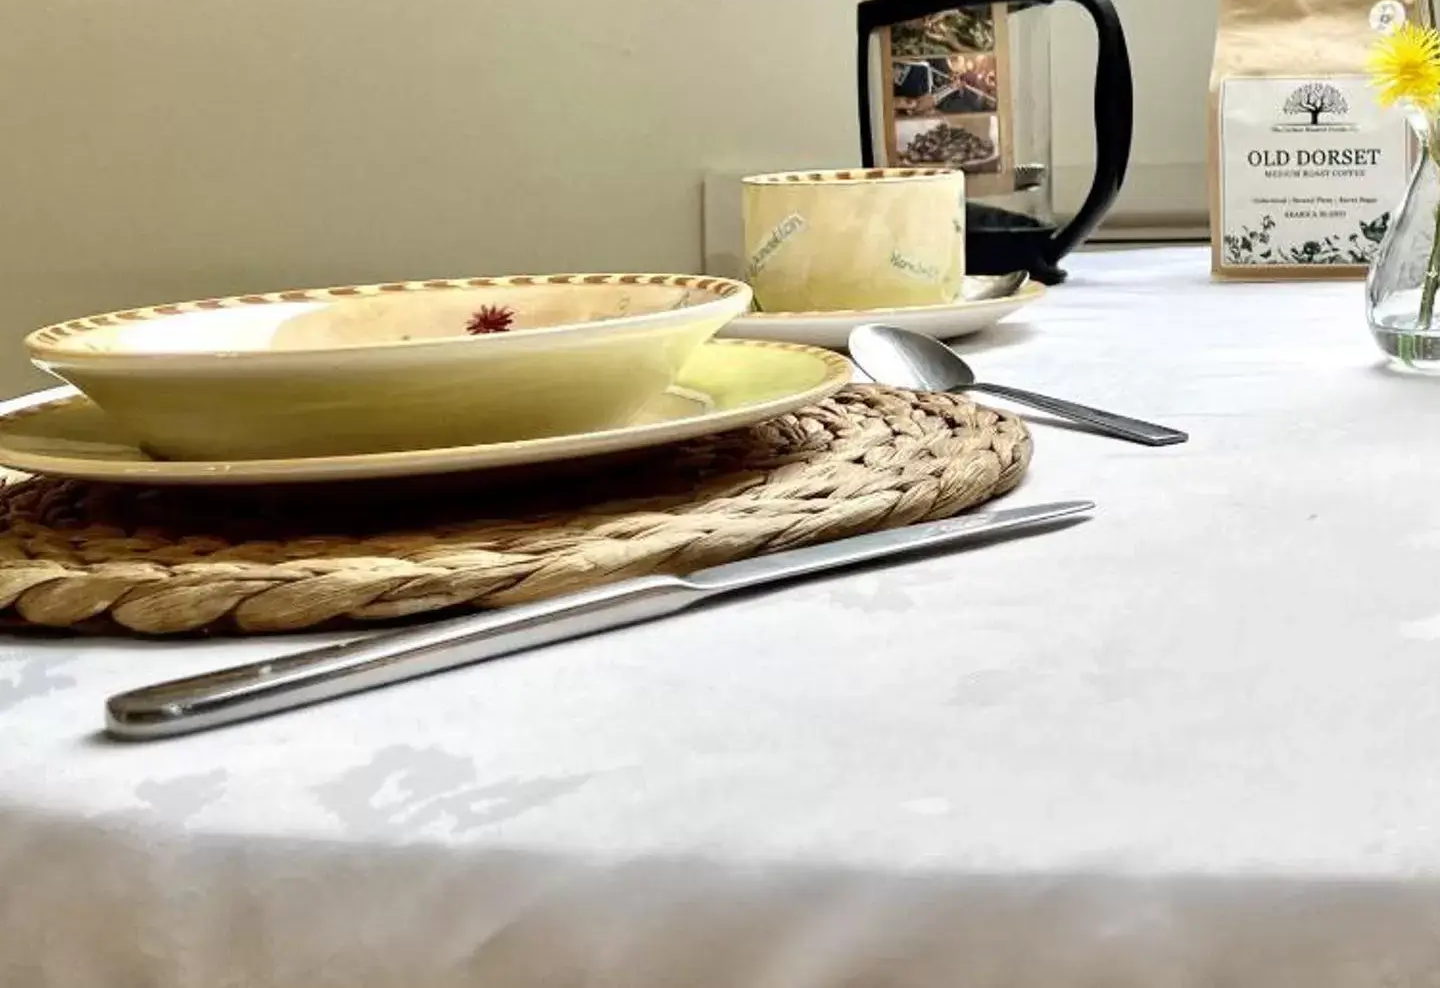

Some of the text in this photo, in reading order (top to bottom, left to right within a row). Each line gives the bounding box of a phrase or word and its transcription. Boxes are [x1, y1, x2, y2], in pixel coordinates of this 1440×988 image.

[1247, 148, 1381, 167] OLD DORSET
[1303, 169, 1330, 179] ROAST
[1332, 168, 1366, 178] COFFEE
